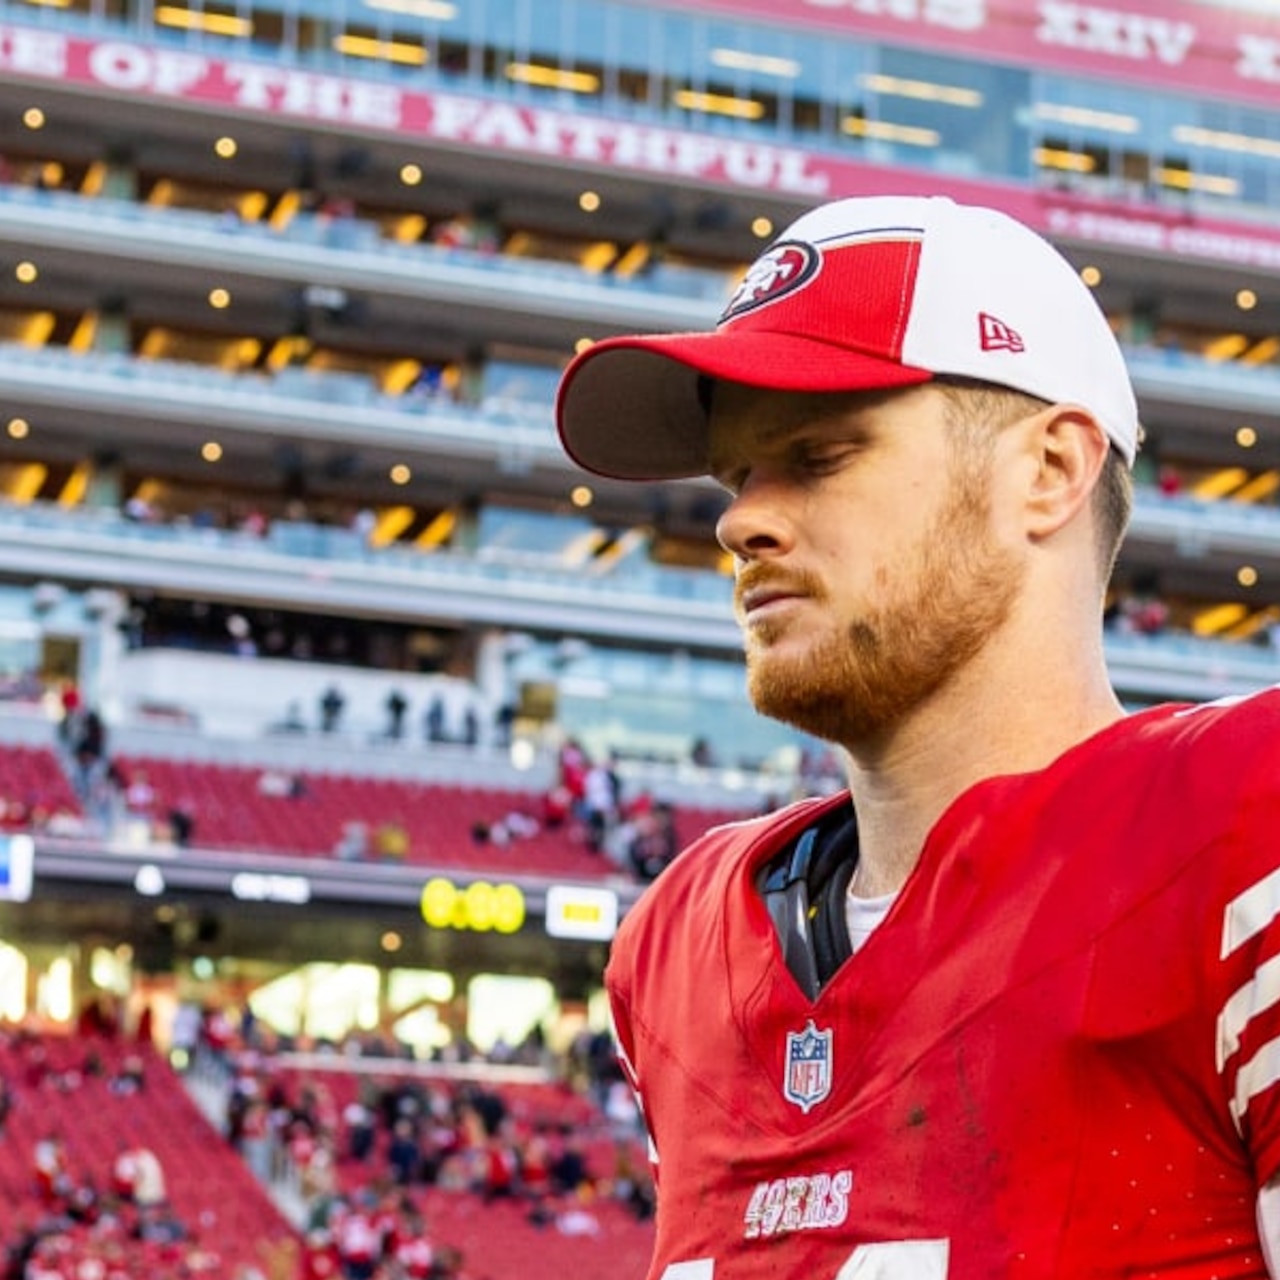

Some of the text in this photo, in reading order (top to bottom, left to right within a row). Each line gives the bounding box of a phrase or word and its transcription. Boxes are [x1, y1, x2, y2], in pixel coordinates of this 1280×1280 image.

[1035, 3, 1194, 64] XXIV
[89, 38, 209, 92] OF
[223, 60, 402, 128] THE
[426, 88, 830, 195] FAITHFUL
